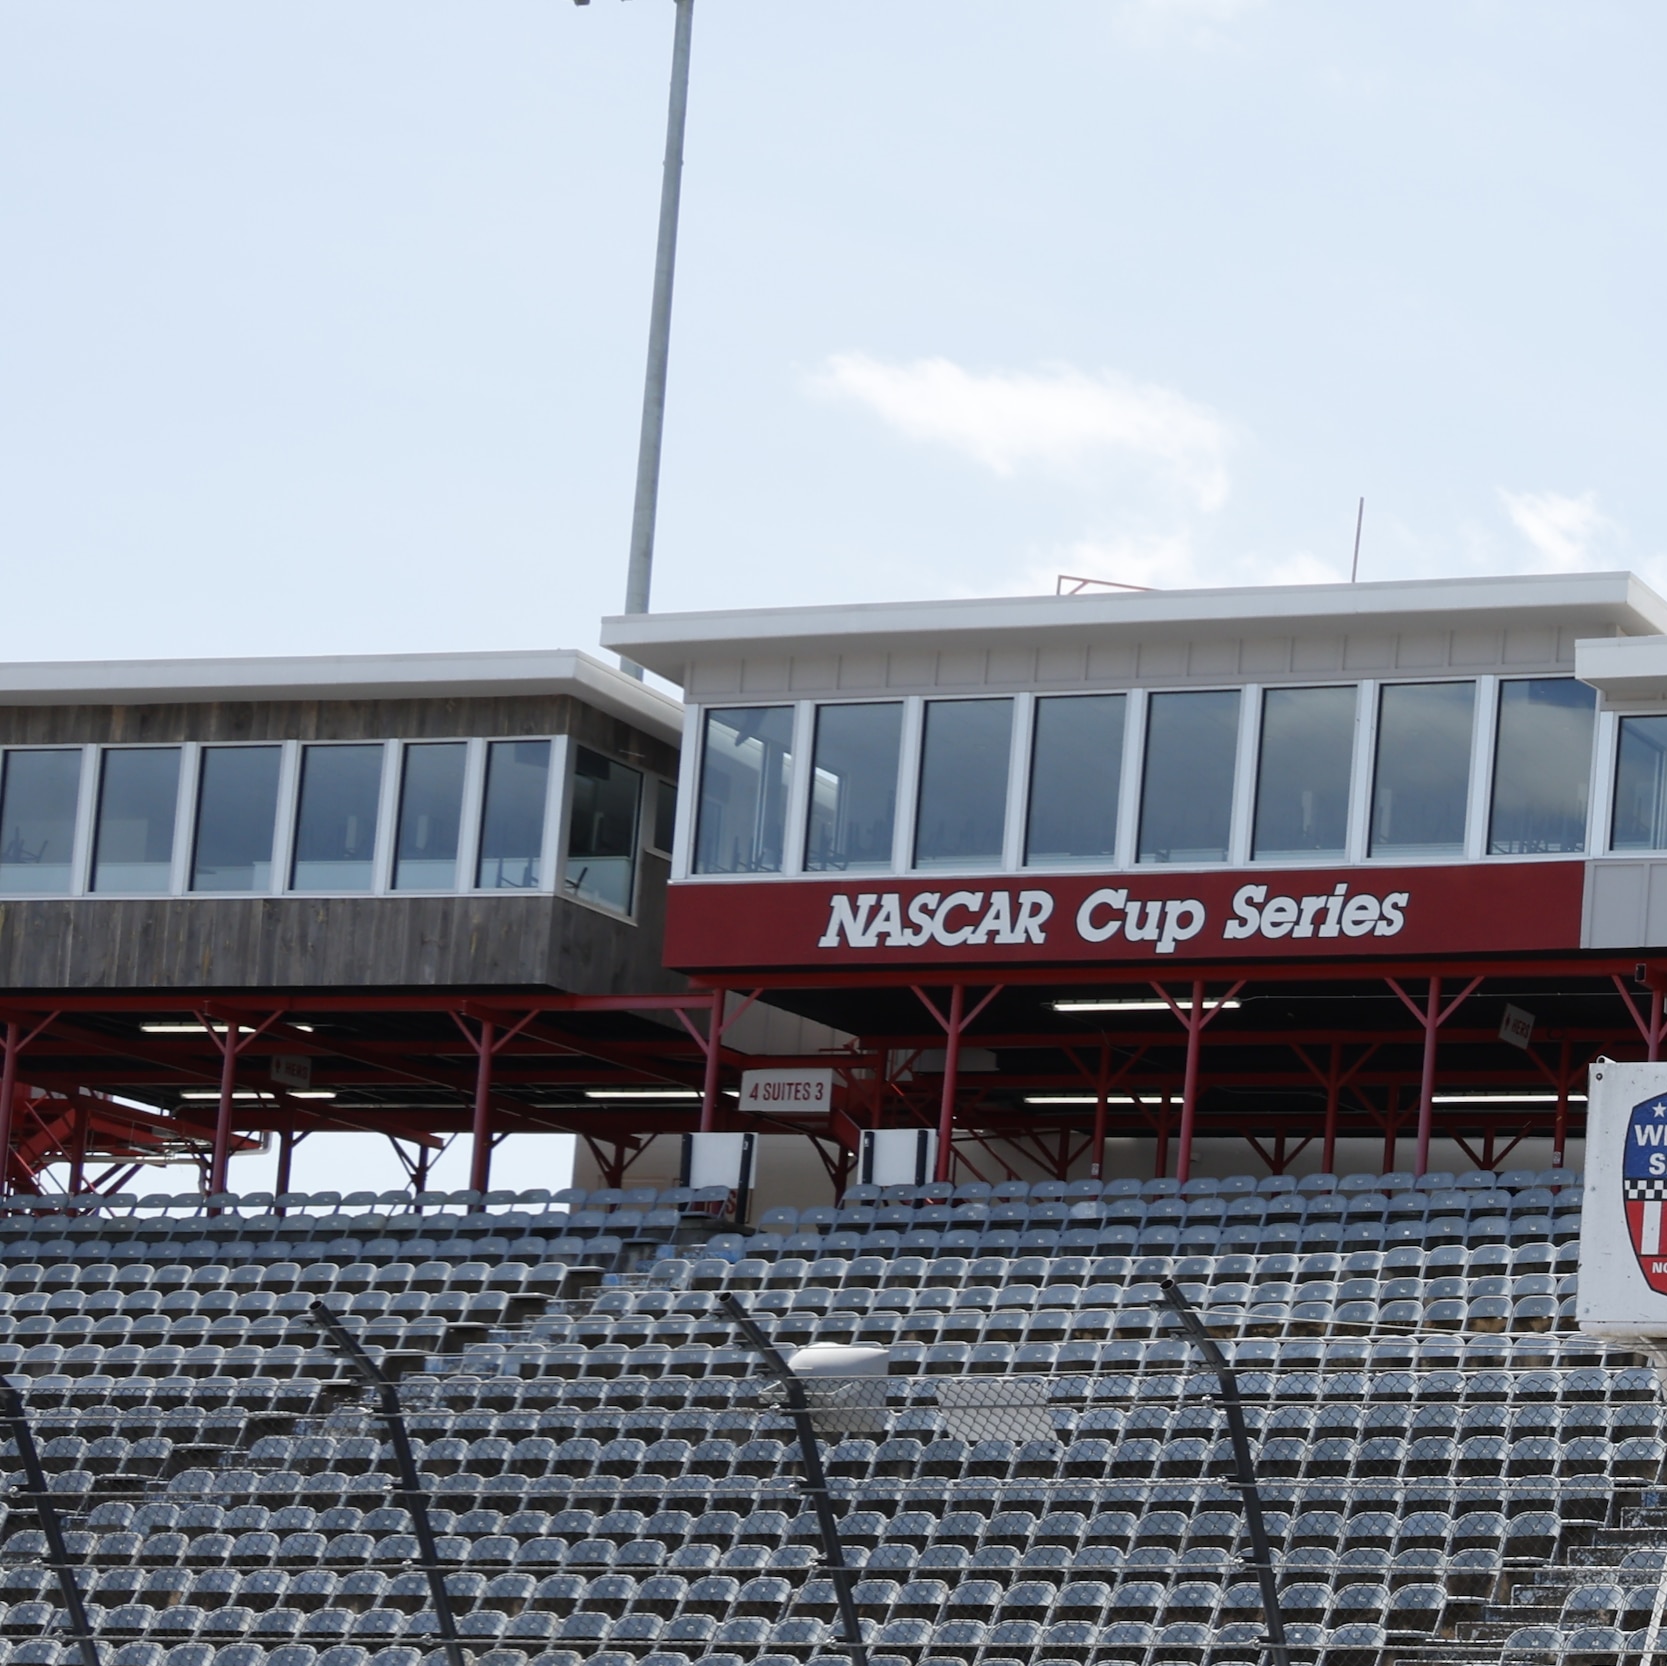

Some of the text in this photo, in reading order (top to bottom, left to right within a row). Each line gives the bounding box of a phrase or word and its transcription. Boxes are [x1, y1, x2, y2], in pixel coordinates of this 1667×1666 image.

[818, 883, 1410, 953] NASCAR Cup Series
[749, 1082, 824, 1101] 4 SUITES 3
